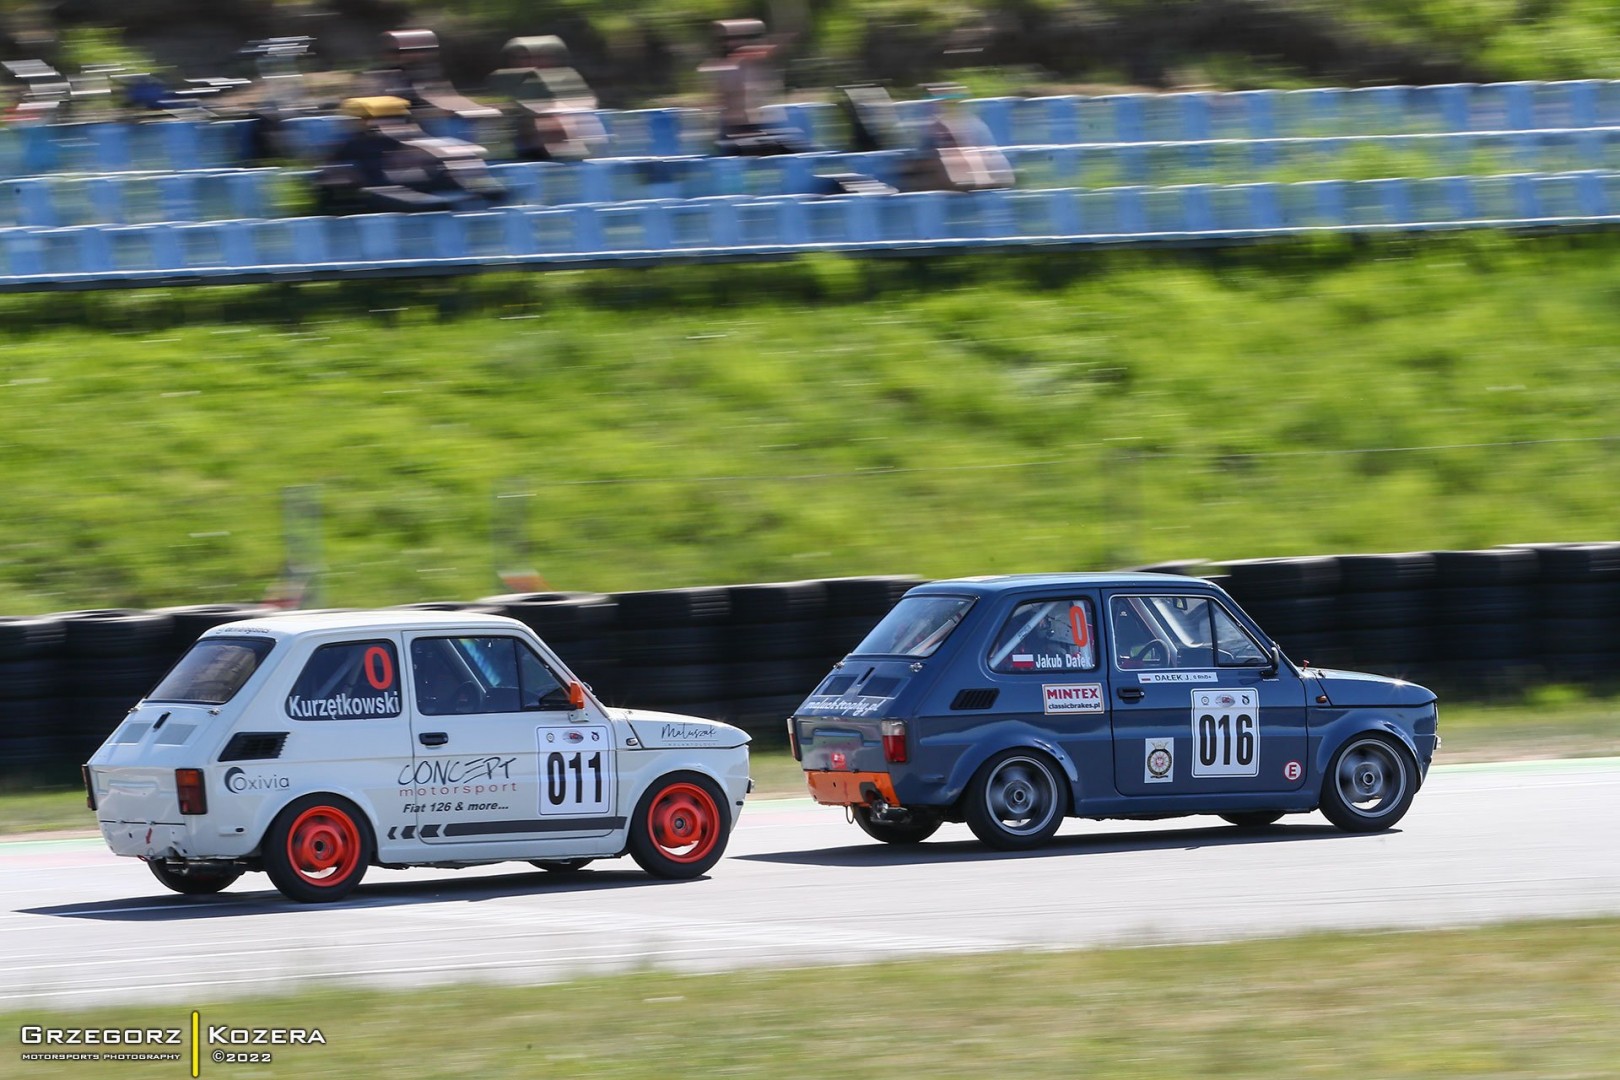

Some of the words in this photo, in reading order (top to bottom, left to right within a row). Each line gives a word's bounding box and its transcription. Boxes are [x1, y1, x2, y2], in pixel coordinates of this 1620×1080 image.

[1069, 605, 1088, 647] 0
[364, 646, 393, 690] 0
[1035, 653, 1062, 668] Jakub
[1046, 688, 1100, 700] MINTEX
[288, 690, 400, 720] Kurzętkowski
[1048, 701, 1101, 710] classicbrakes.pl
[1199, 714, 1254, 767] 016
[398, 756, 517, 786] CONCEPT
[547, 751, 602, 806] 011
[1288, 764, 1297, 778] E
[232, 774, 290, 791] Oxivia
[399, 782, 517, 797] motorsport
[403, 803, 426, 813] Fiat
[430, 802, 452, 812] 126
[454, 801, 463, 811] &
[467, 802, 509, 811] more...
